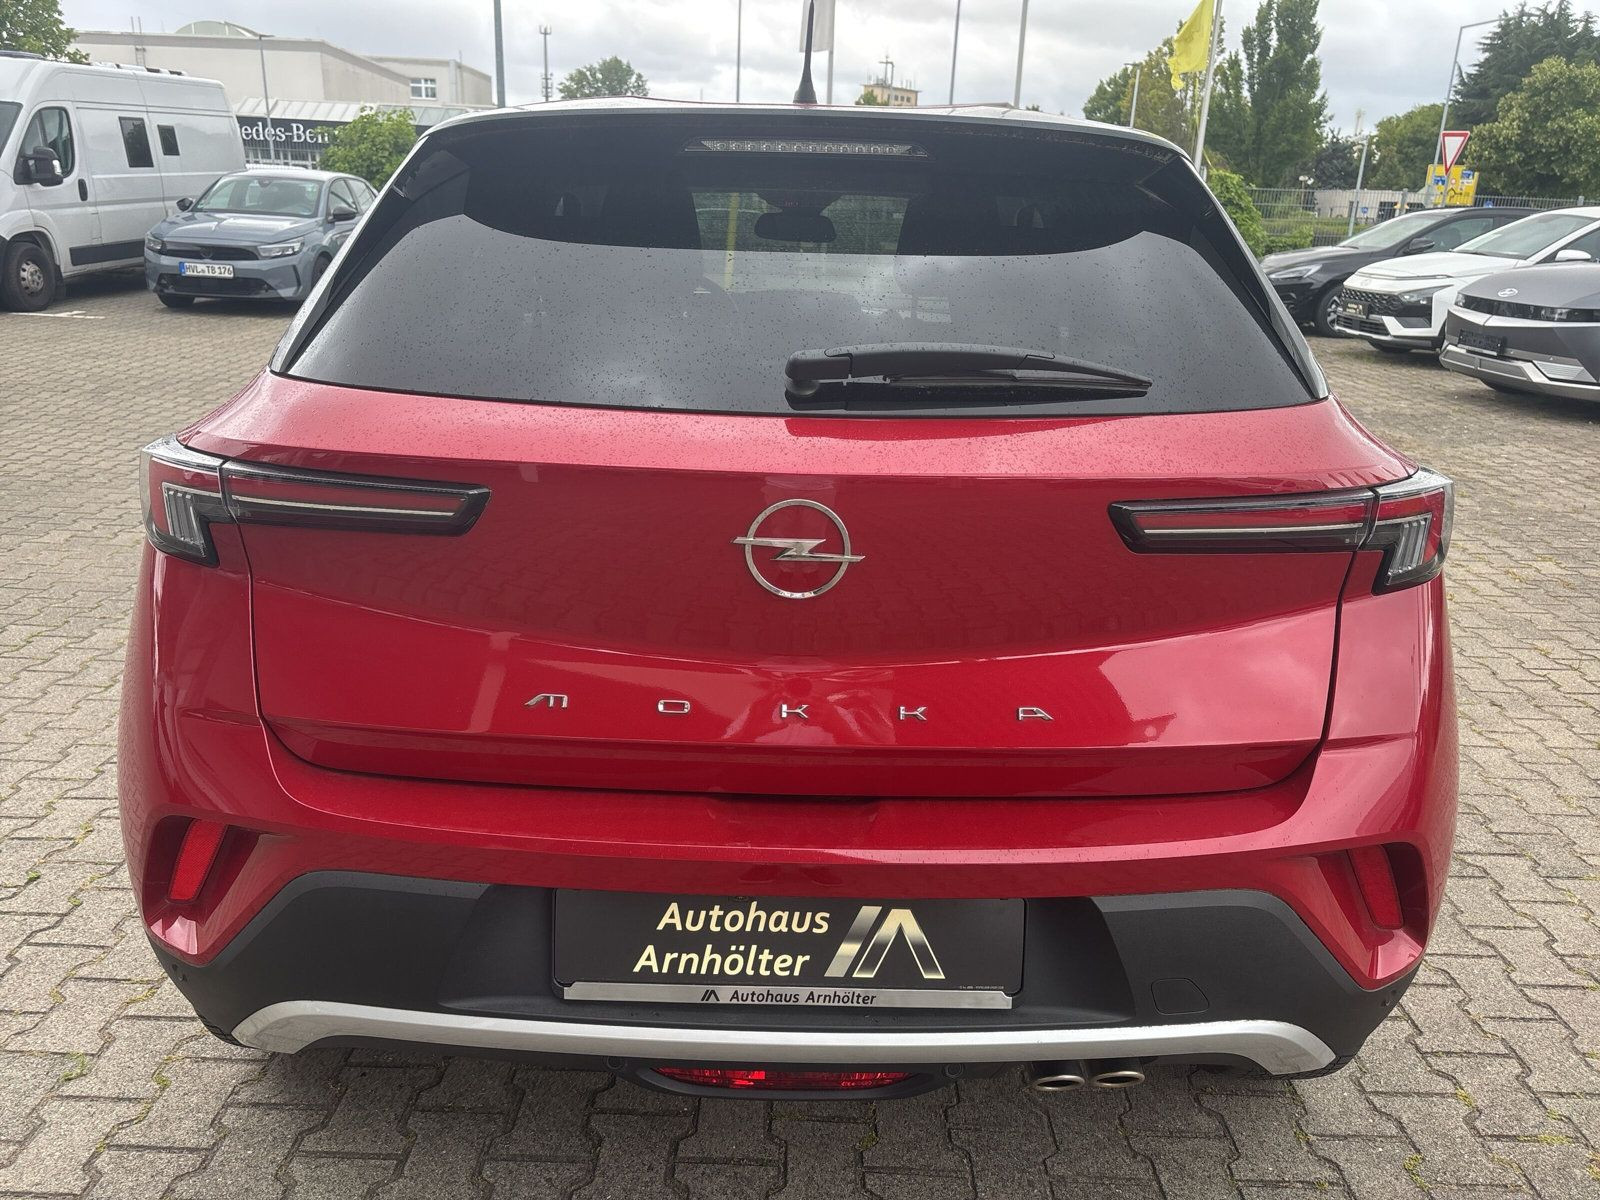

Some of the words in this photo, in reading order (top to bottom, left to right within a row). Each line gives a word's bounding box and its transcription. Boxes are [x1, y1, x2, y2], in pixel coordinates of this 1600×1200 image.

[241, 121, 330, 144] edes-Ben
[185, 264, 201, 274] HVL
[206, 265, 217, 275] TB
[217, 266, 233, 276] 176
[524, 693, 1054, 721] MOKKA
[656, 901, 830, 934] Autohaus
[633, 944, 811, 977] Arnhölter
[729, 989, 800, 1003] Autohaus
[805, 991, 877, 1005] Arnhölter
